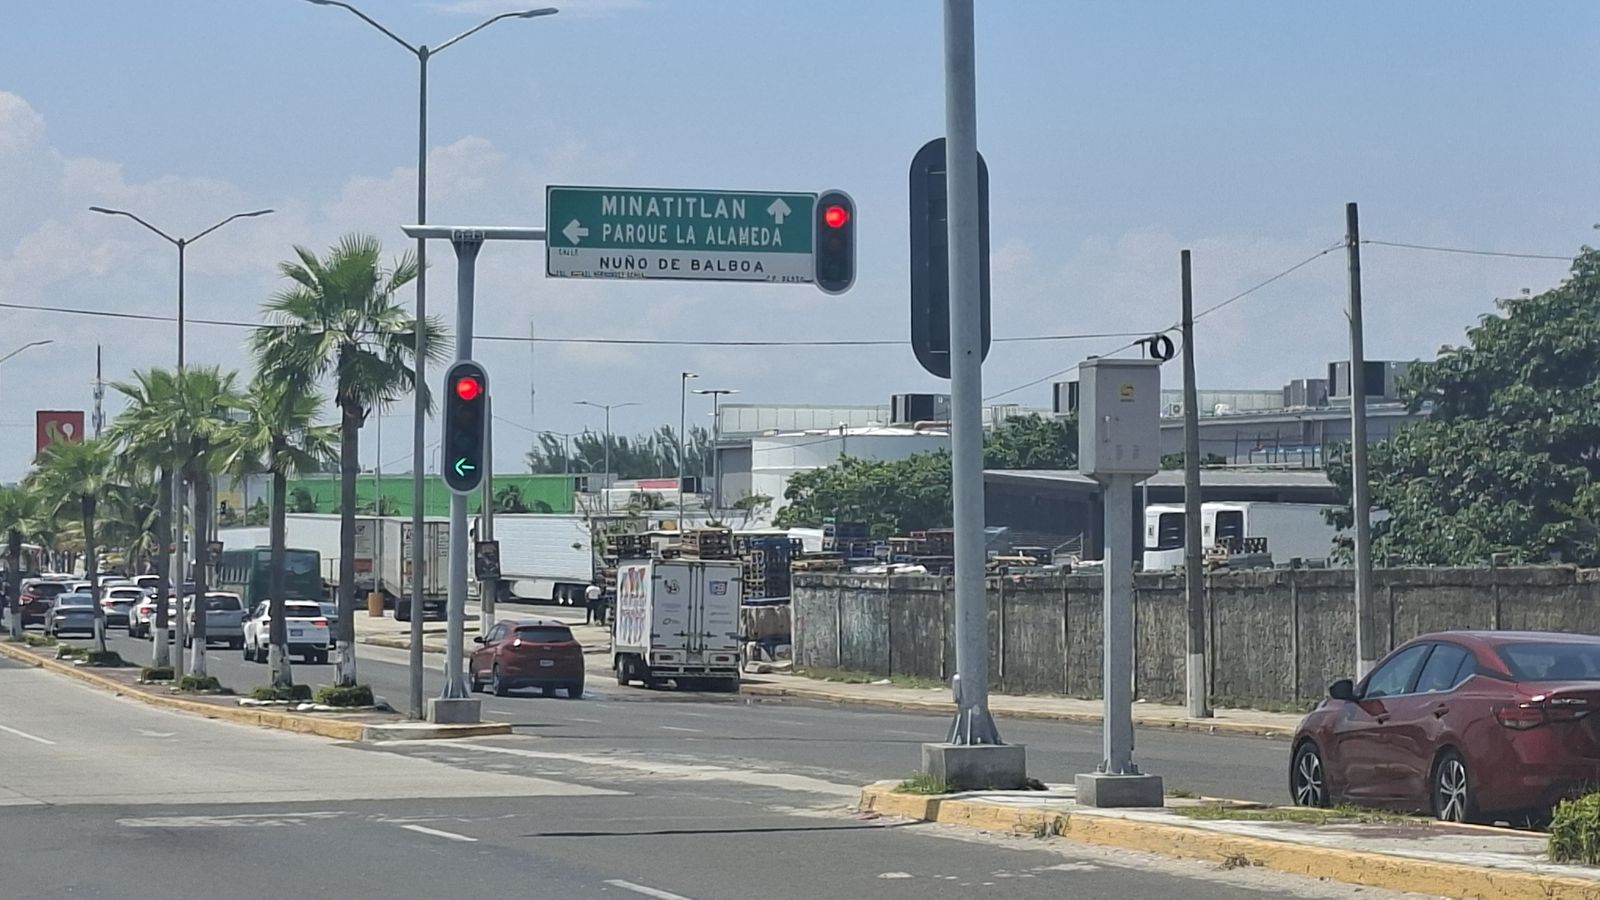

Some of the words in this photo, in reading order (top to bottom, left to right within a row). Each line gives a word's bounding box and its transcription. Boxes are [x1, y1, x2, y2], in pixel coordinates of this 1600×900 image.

[602, 195, 746, 220] MINATITLAN
[602, 223, 668, 244] PARQUE
[676, 224, 696, 245] LA
[705, 225, 783, 247] ALAMEDA
[599, 255, 648, 270] NUÑO
[658, 258, 681, 270] DE
[691, 259, 764, 273] BALBOA
